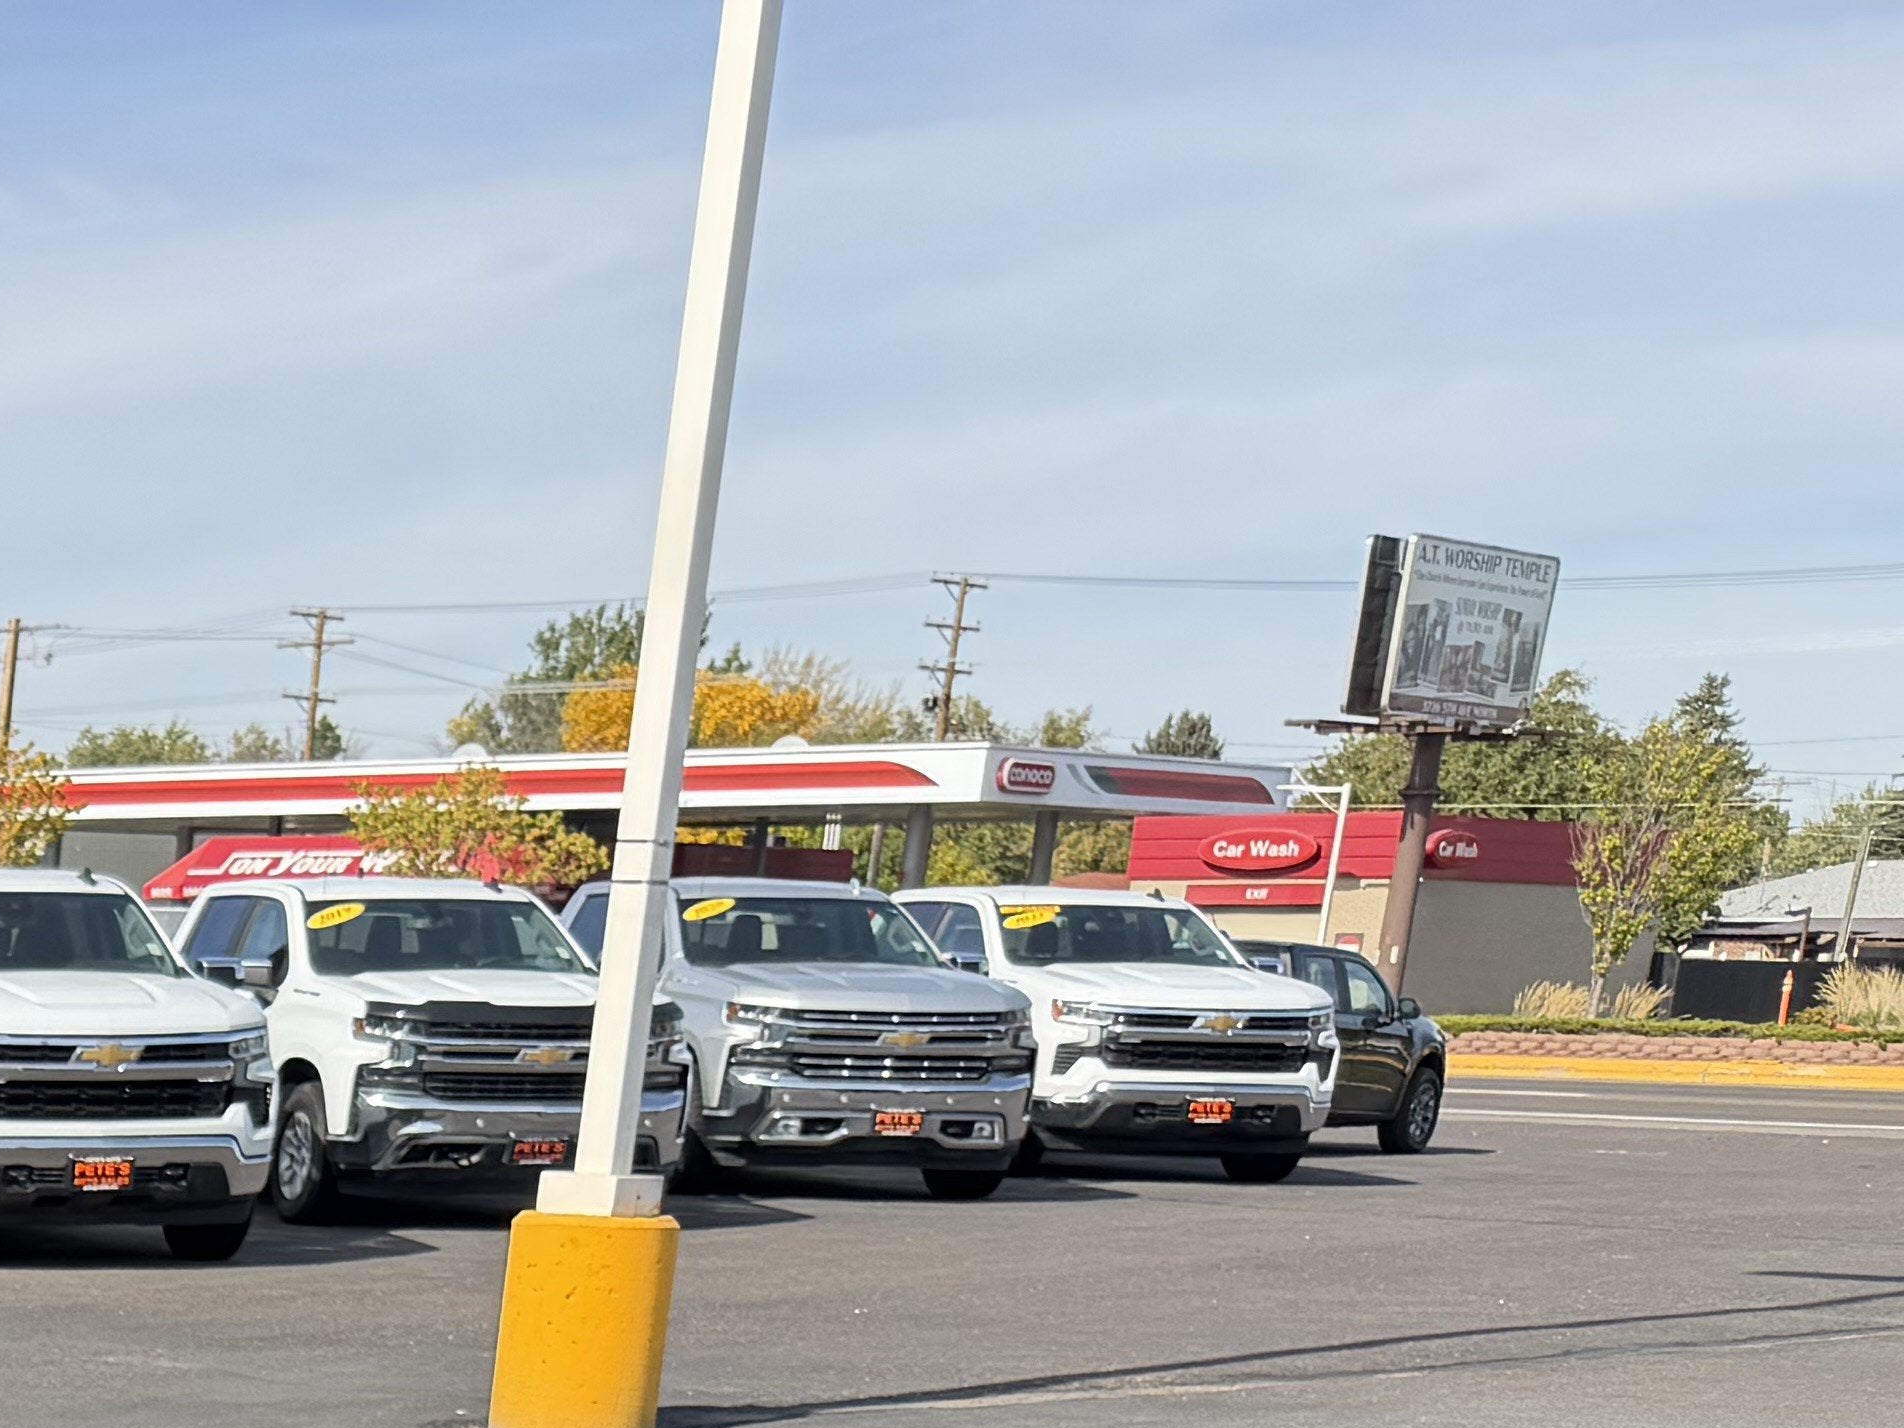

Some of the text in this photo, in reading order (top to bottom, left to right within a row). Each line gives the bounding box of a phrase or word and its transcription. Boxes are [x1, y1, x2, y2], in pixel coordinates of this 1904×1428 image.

[1445, 547, 1502, 574] WORSHIP
[1504, 556, 1552, 584] TEMPLE
[1212, 839, 1300, 858] Car Wash
[1438, 841, 1478, 858] Car Wash
